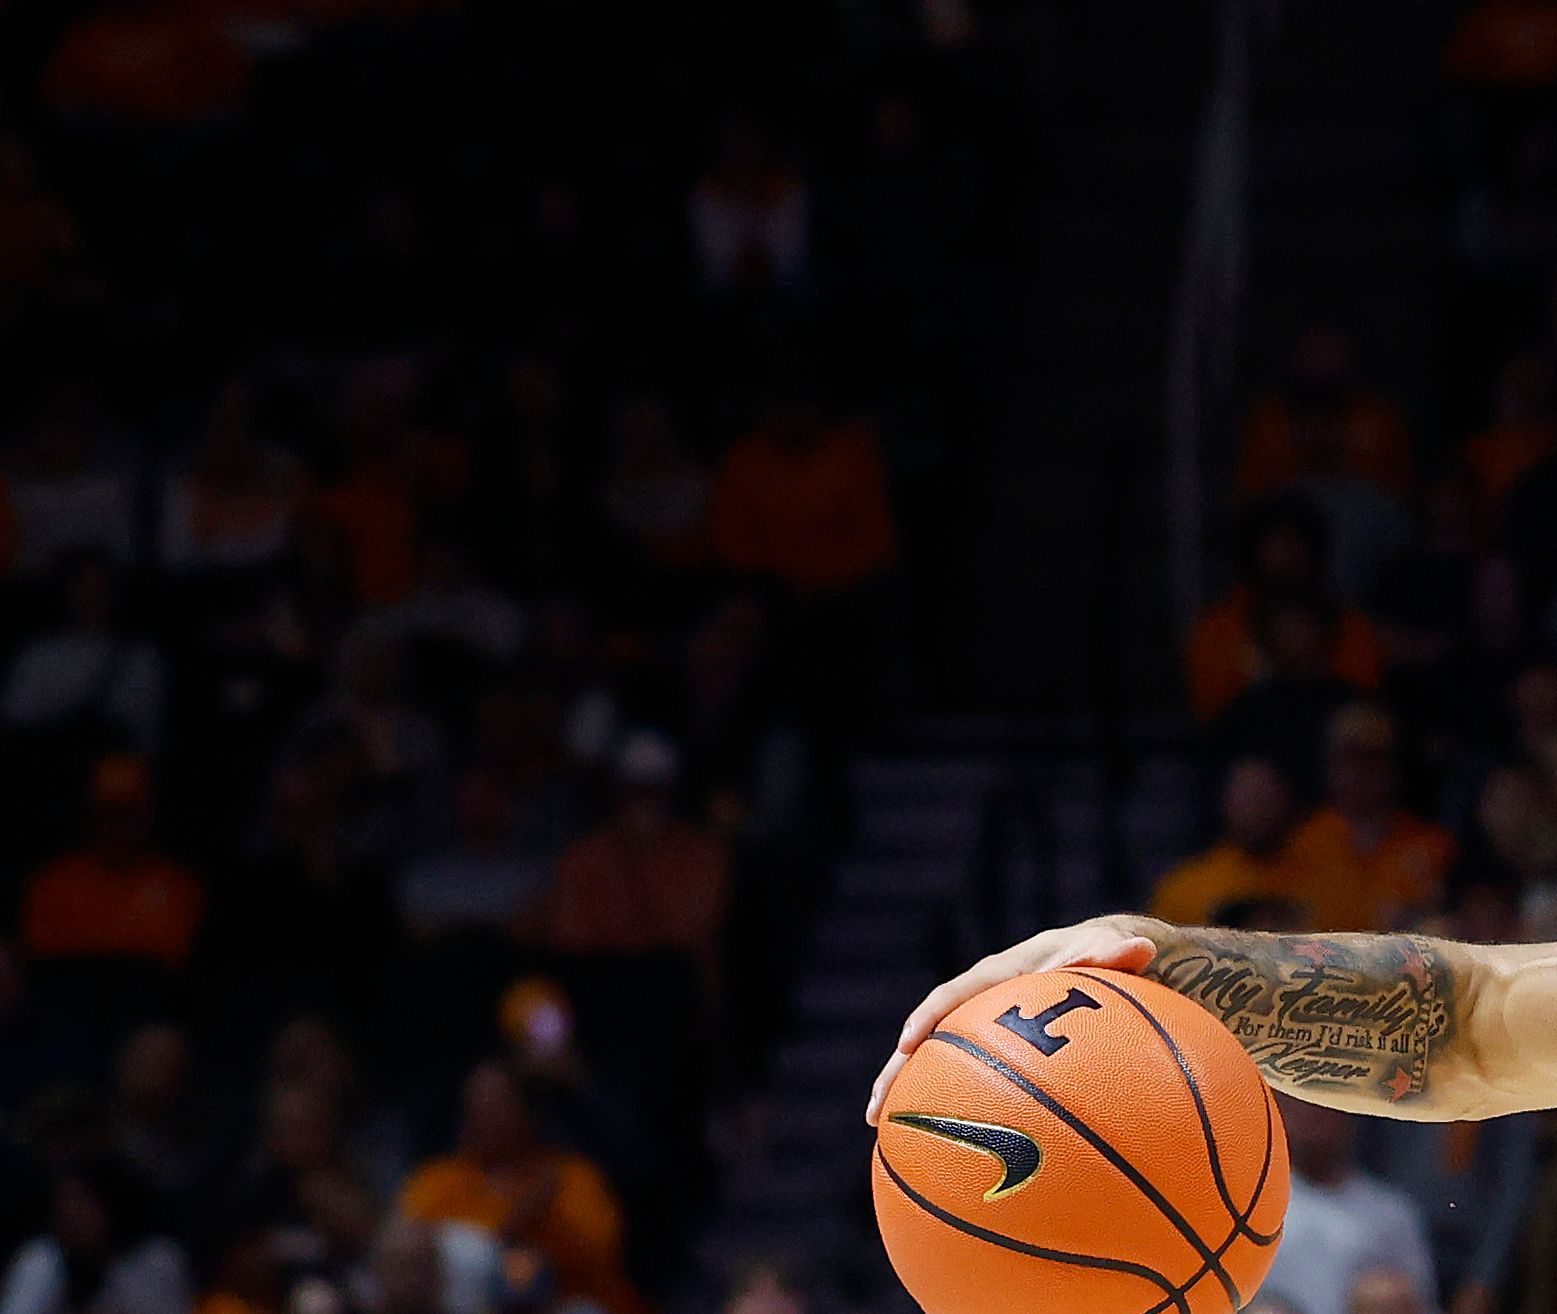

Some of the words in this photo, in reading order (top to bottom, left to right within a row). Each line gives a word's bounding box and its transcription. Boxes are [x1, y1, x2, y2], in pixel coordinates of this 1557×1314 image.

[993, 987, 1103, 1057] T
[1268, 1022, 1312, 1042] them
[1391, 1034, 1410, 1054] all
